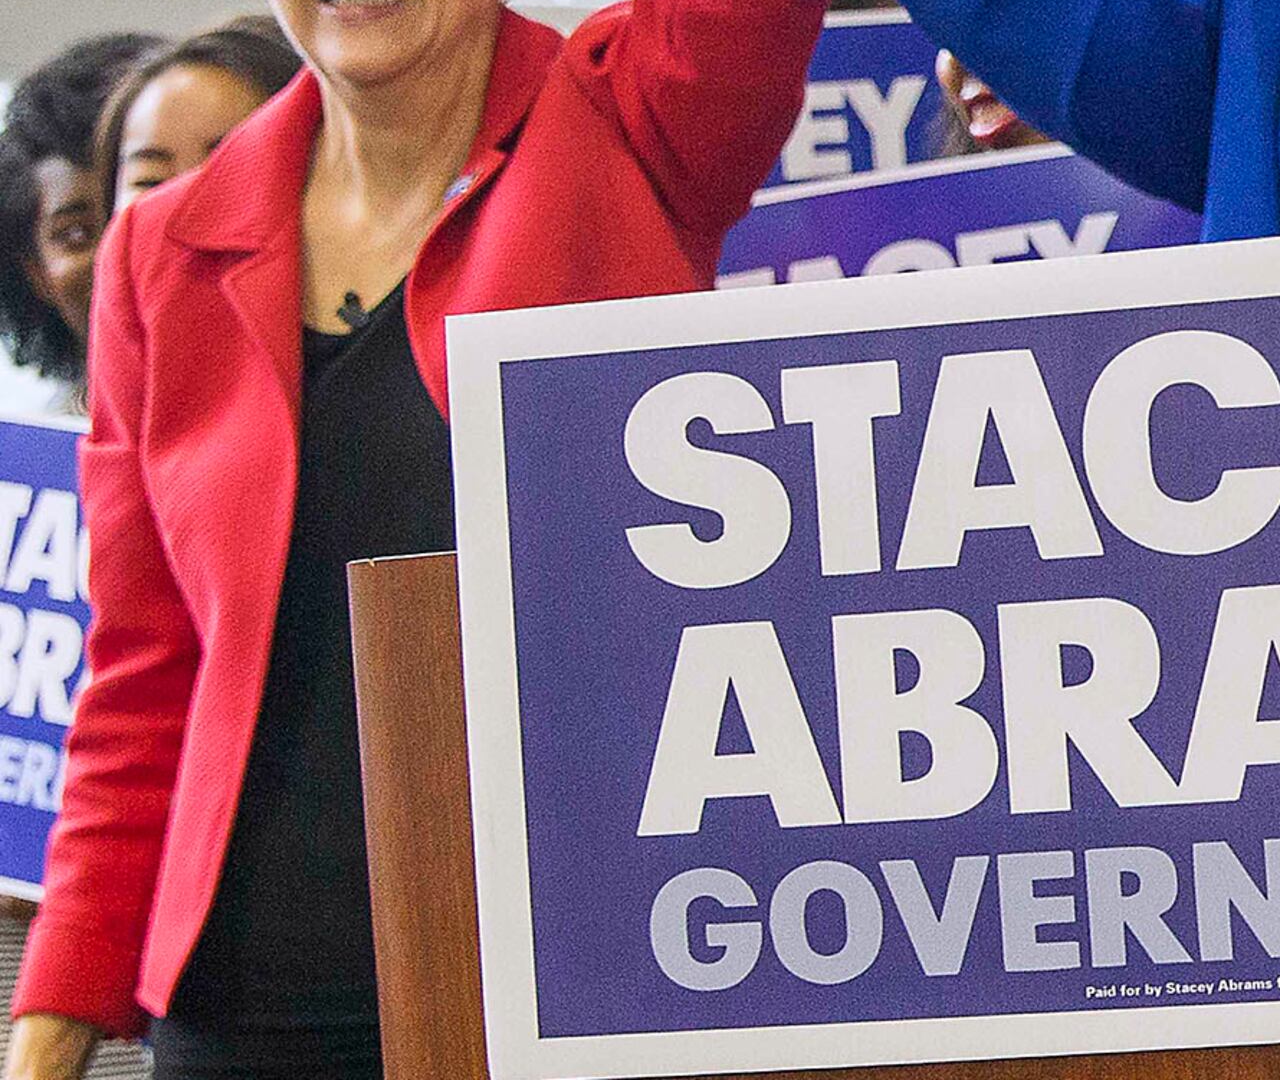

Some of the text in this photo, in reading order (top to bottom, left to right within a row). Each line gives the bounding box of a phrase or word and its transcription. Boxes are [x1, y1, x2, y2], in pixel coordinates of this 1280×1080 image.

[1085, 985, 1116, 998] Paid
[1120, 984, 1141, 997] for
[1144, 983, 1162, 997] by
[1165, 982, 1214, 995] Stacey
[1218, 979, 1273, 991] Abrams
